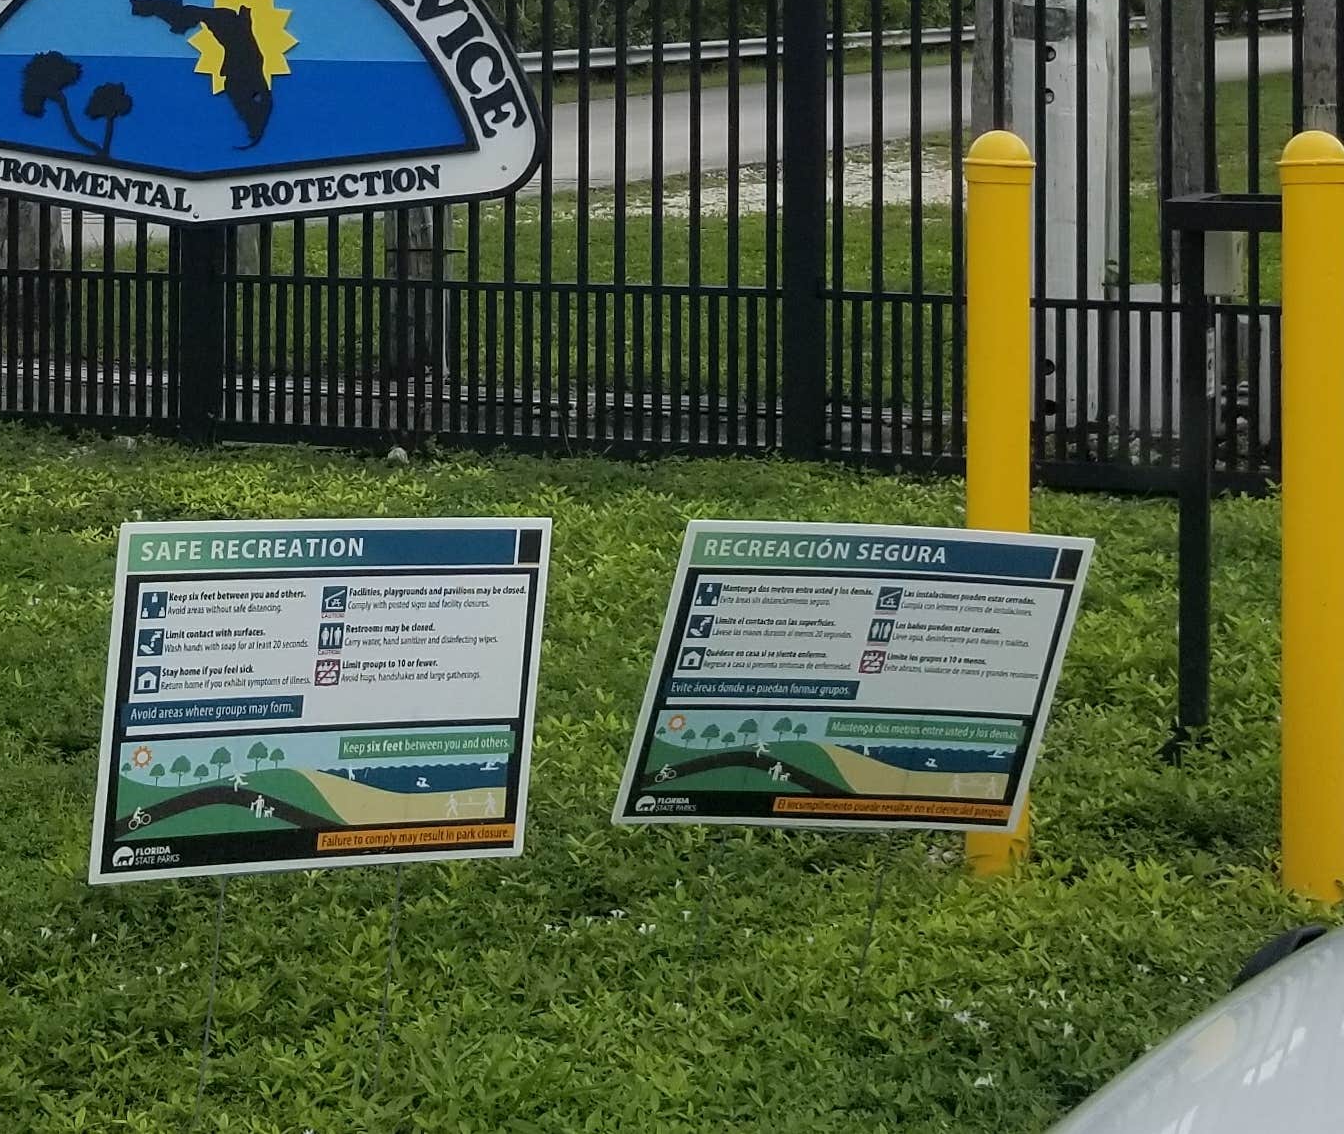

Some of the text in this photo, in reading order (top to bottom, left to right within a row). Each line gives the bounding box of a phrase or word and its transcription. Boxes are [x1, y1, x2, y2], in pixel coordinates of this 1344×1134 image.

[231, 165, 441, 211] PROTECTION
[141, 537, 364, 561] SAFE RECREATION
[704, 538, 946, 563] RECREACIÓN SEGURA
[169, 589, 306, 603] Keep six feet between you and others.
[384, 587, 427, 598] playgrounds
[429, 587, 442, 595] and
[443, 587, 475, 597] pavilions
[476, 588, 491, 597] may
[493, 586, 501, 595] be
[503, 586, 526, 595] closed.
[166, 628, 266, 639] Limit contact with surfaces.
[346, 623, 436, 634] Restrooms may be closed.
[162, 668, 178, 678] Stay
[179, 667, 201, 676] home
[202, 666, 208, 675] if
[209, 668, 222, 677] you
[224, 665, 238, 674] feel
[342, 660, 360, 669] Limit
[362, 662, 387, 670] groups
[389, 659, 396, 668] to
[398, 659, 406, 667] 10
[416, 659, 438, 667] fewer.
[671, 682, 850, 697] Evite áreas donde se puedan formar grupos.
[131, 702, 294, 720] Avoid areas where groups may form.
[343, 737, 510, 755] Keep six feet between you and others.
[322, 828, 510, 846] Failure to comply may result in park closure.
[135, 846, 171, 856] FLORIDA
[135, 854, 180, 865] STATE PARKS
